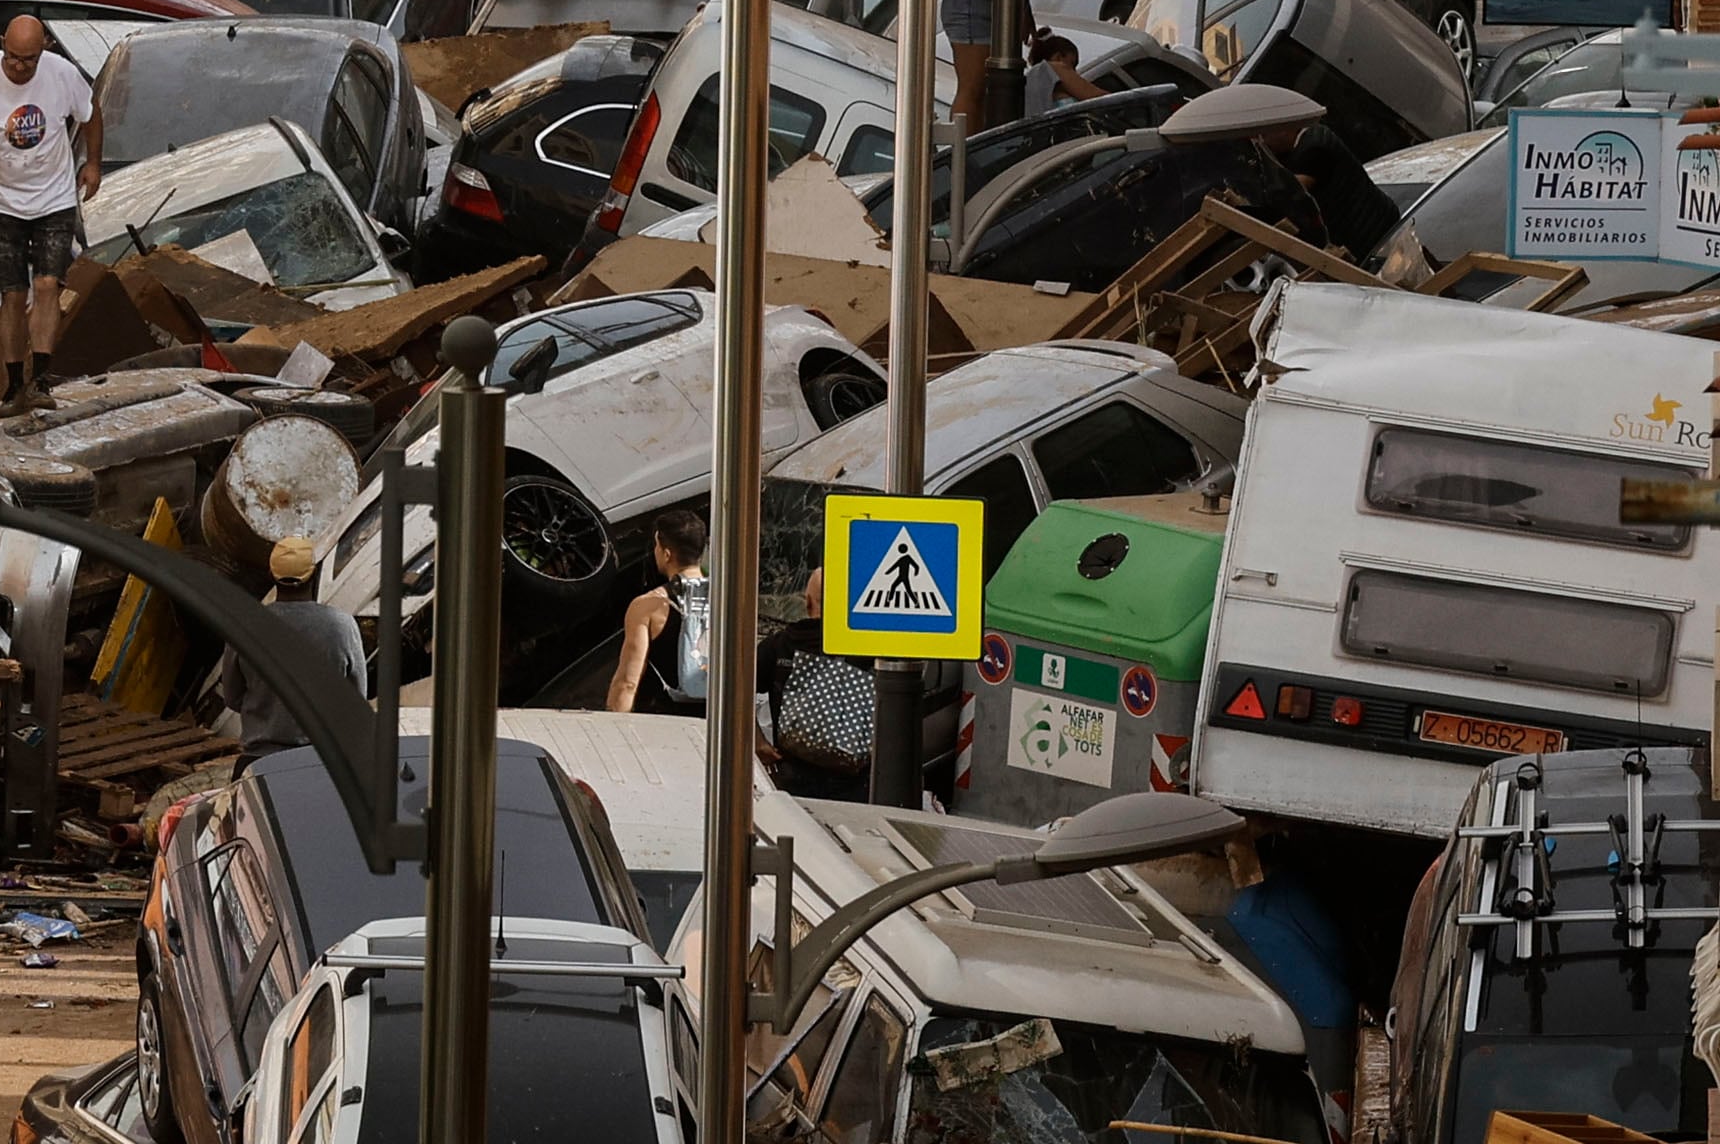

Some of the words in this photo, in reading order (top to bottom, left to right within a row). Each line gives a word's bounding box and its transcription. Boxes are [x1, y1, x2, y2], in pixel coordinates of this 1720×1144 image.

[12, 113, 41, 128] XXVI
[1525, 143, 1593, 170] INMO
[1534, 173, 1648, 199] HÁBITAT
[1525, 216, 1605, 229] SERVICIOS
[1525, 231, 1647, 243] INMOBILIARIOS
[1609, 413, 1664, 443] Sun
[1061, 704, 1105, 724] ALFAFAR
[1070, 714, 1089, 729] NET
[1074, 739, 1102, 756] TOTS
